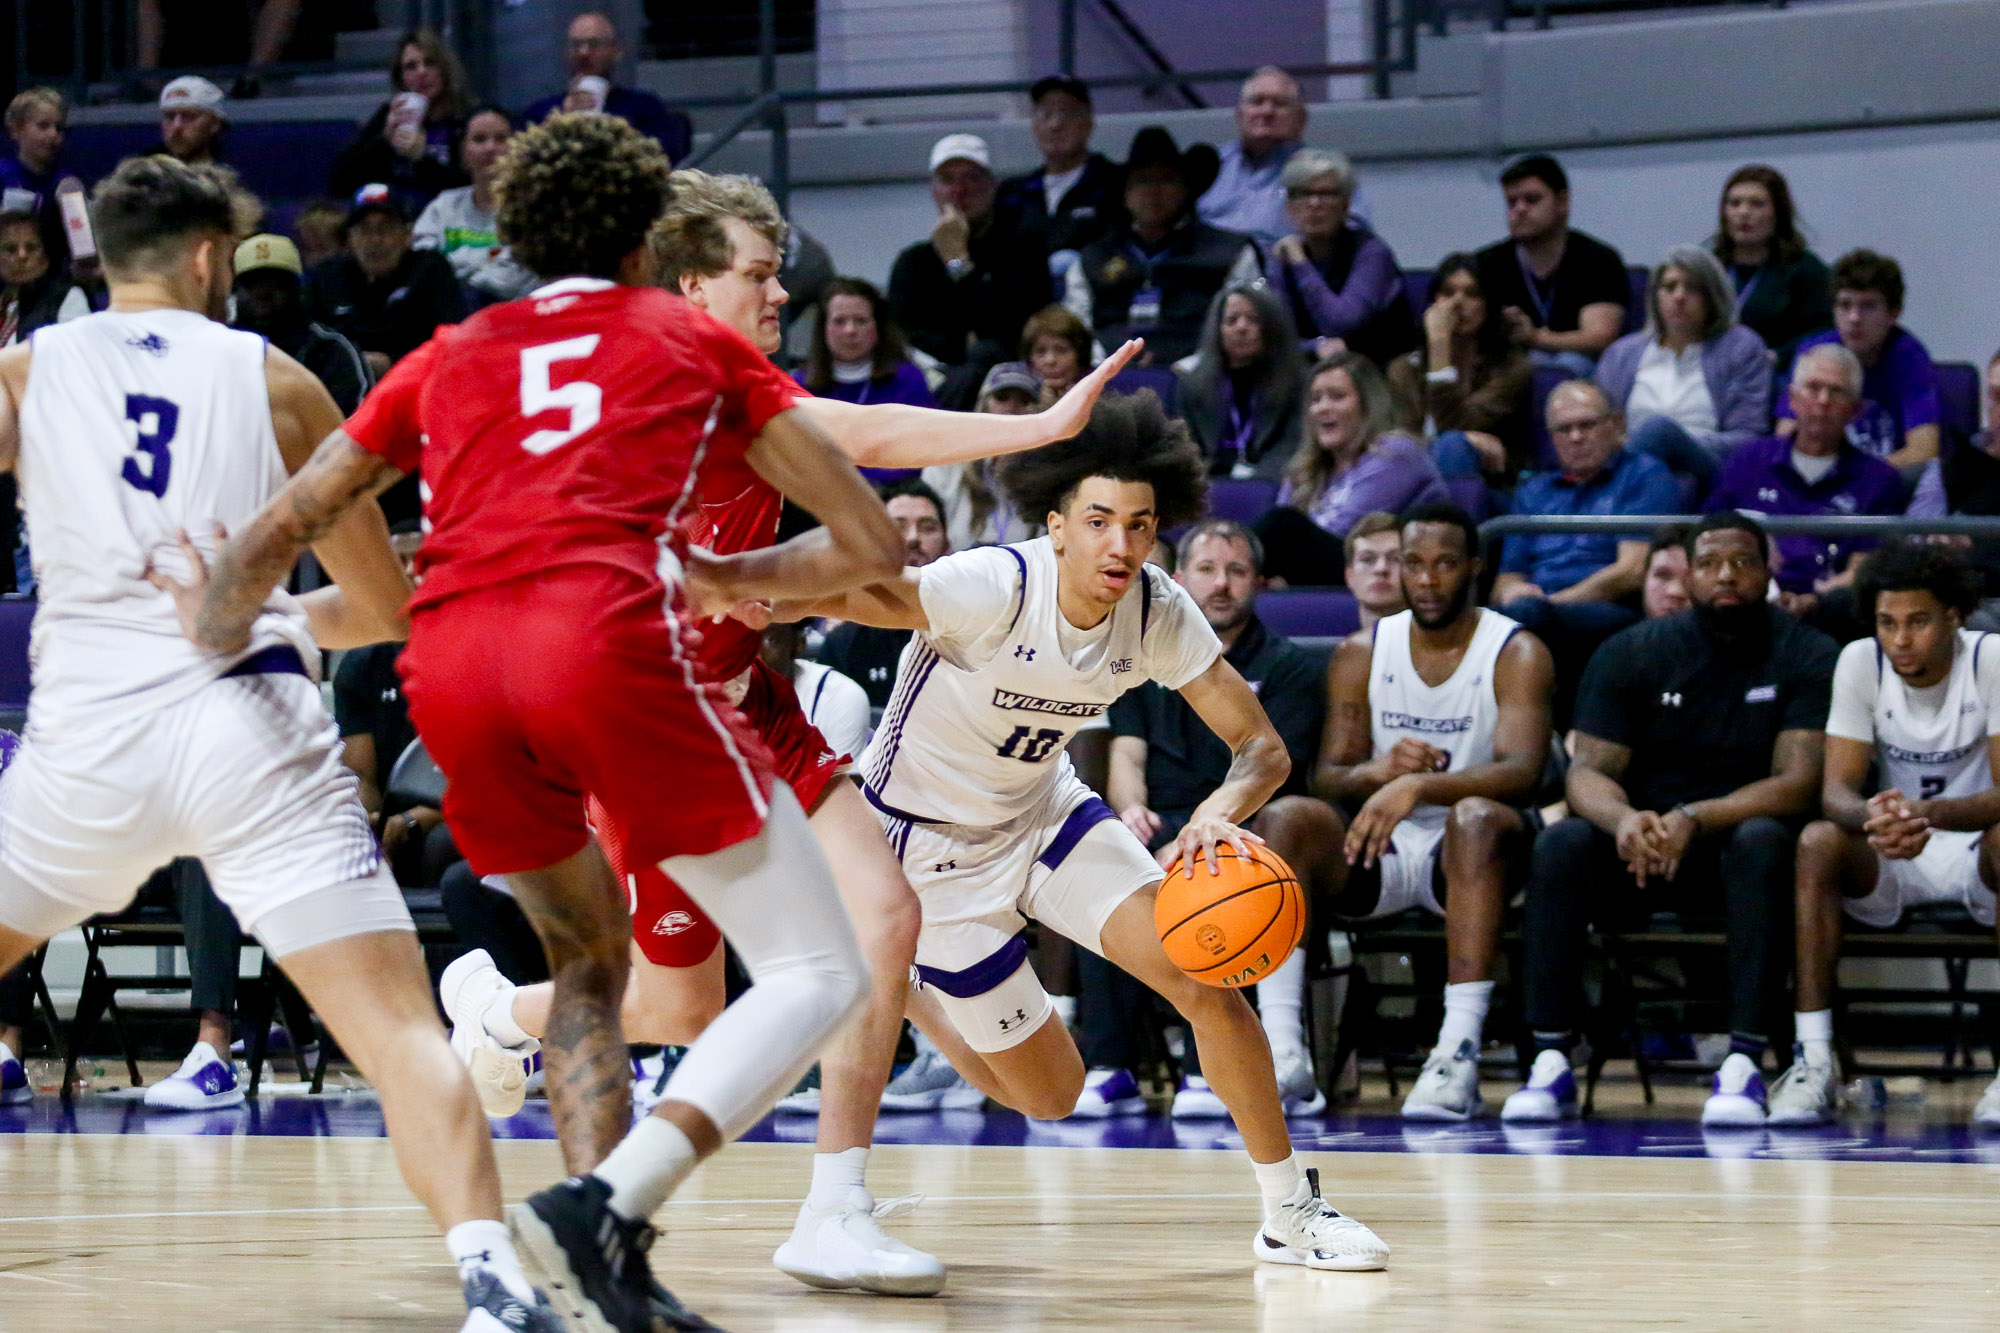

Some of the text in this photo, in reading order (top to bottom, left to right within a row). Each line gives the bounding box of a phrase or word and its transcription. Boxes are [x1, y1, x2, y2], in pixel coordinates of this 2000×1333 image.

[519, 333, 603, 457] 5
[122, 393, 180, 499] 3
[993, 688, 1110, 717] WILDCATS
[997, 725, 1065, 763] 10
